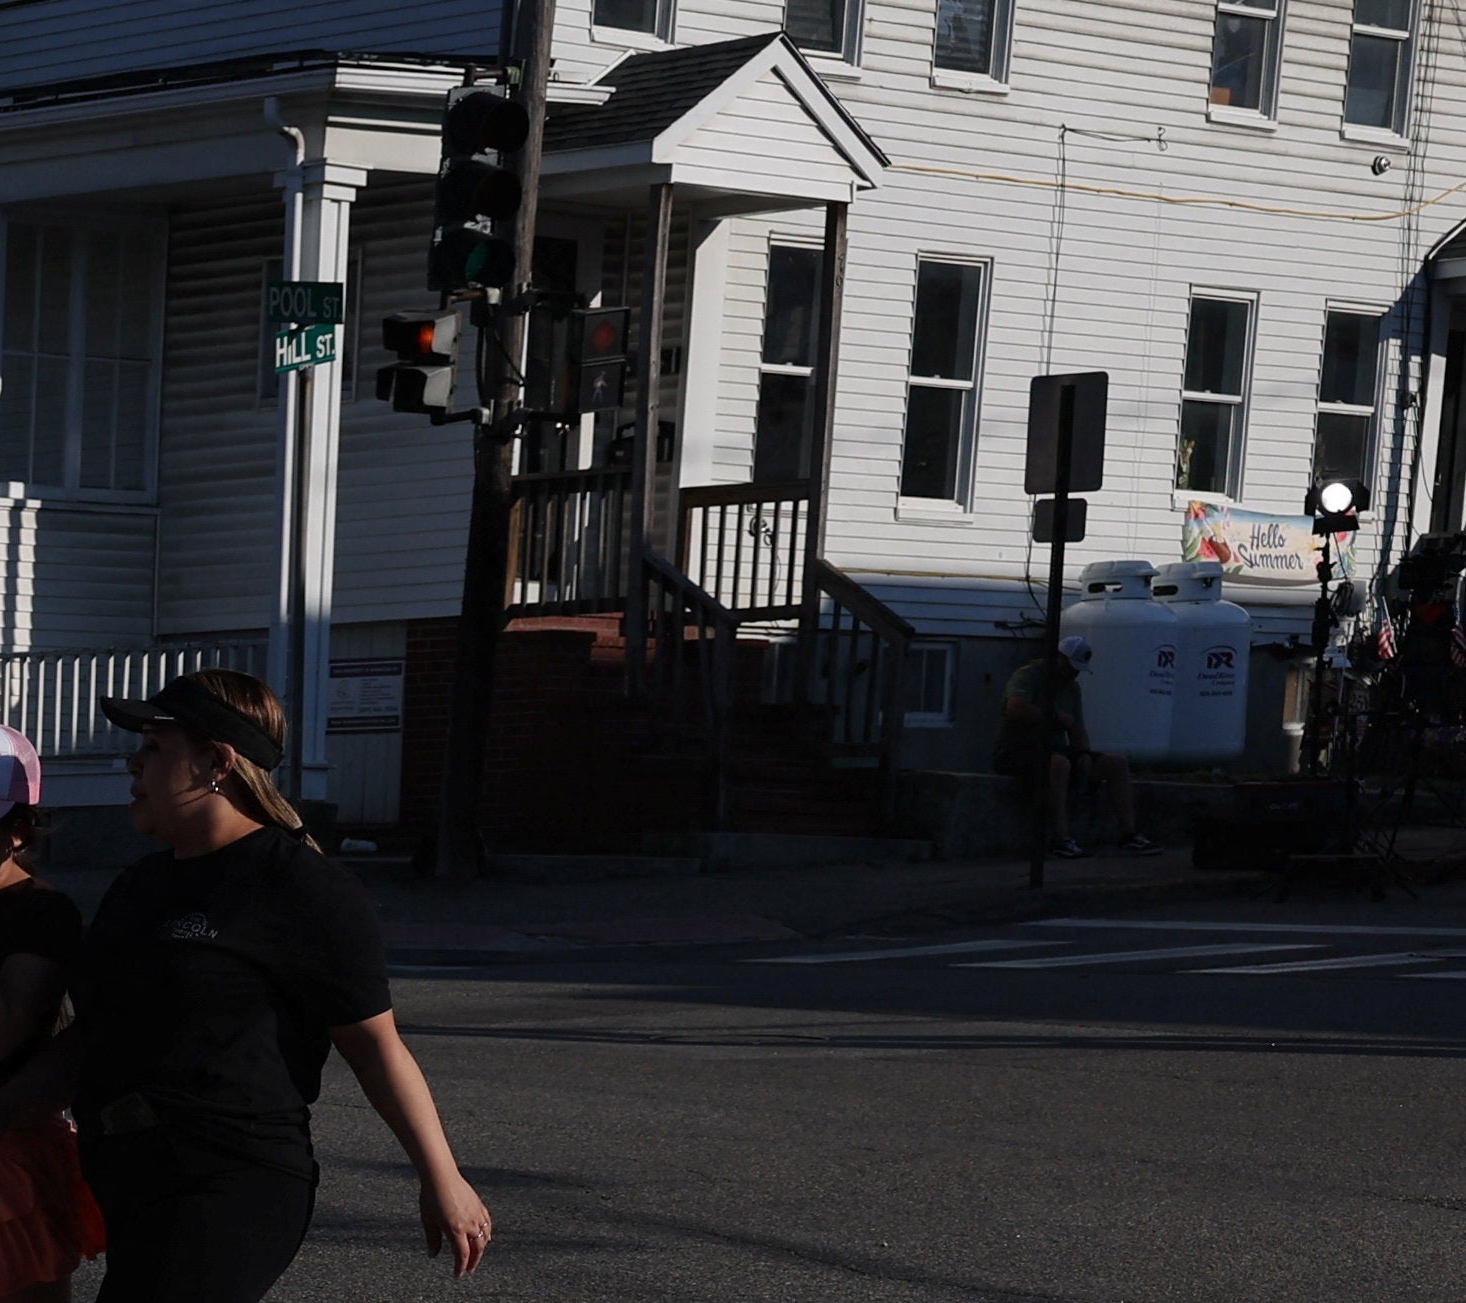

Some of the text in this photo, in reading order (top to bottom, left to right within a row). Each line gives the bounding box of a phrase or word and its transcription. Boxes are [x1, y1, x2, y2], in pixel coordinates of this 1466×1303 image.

[269, 286, 342, 318] POOL ST.
[275, 331, 335, 368] HILL ST.
[1250, 522, 1286, 551] Hello
[1238, 542, 1304, 570] Summer
